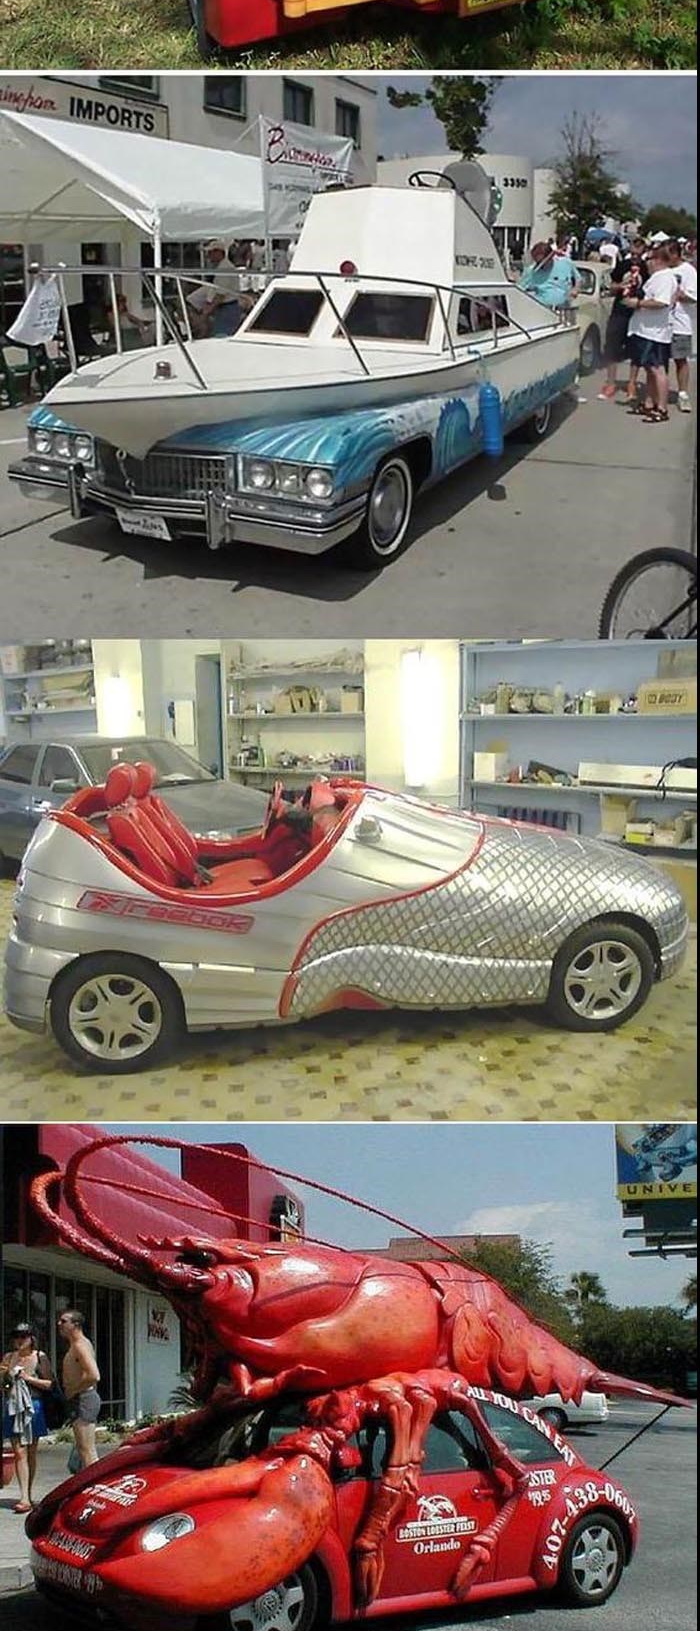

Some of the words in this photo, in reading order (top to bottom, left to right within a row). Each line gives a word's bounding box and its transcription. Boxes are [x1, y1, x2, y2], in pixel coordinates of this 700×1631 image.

[69, 96, 155, 132] IMPORTS
[627, 1182, 693, 1195] UNIVE
[467, 1386, 490, 1402] ALL
[491, 1391, 519, 1414] YOU
[521, 1407, 551, 1438] CAN
[553, 1435, 577, 1467] EAT
[414, 1537, 461, 1554] Orlando
